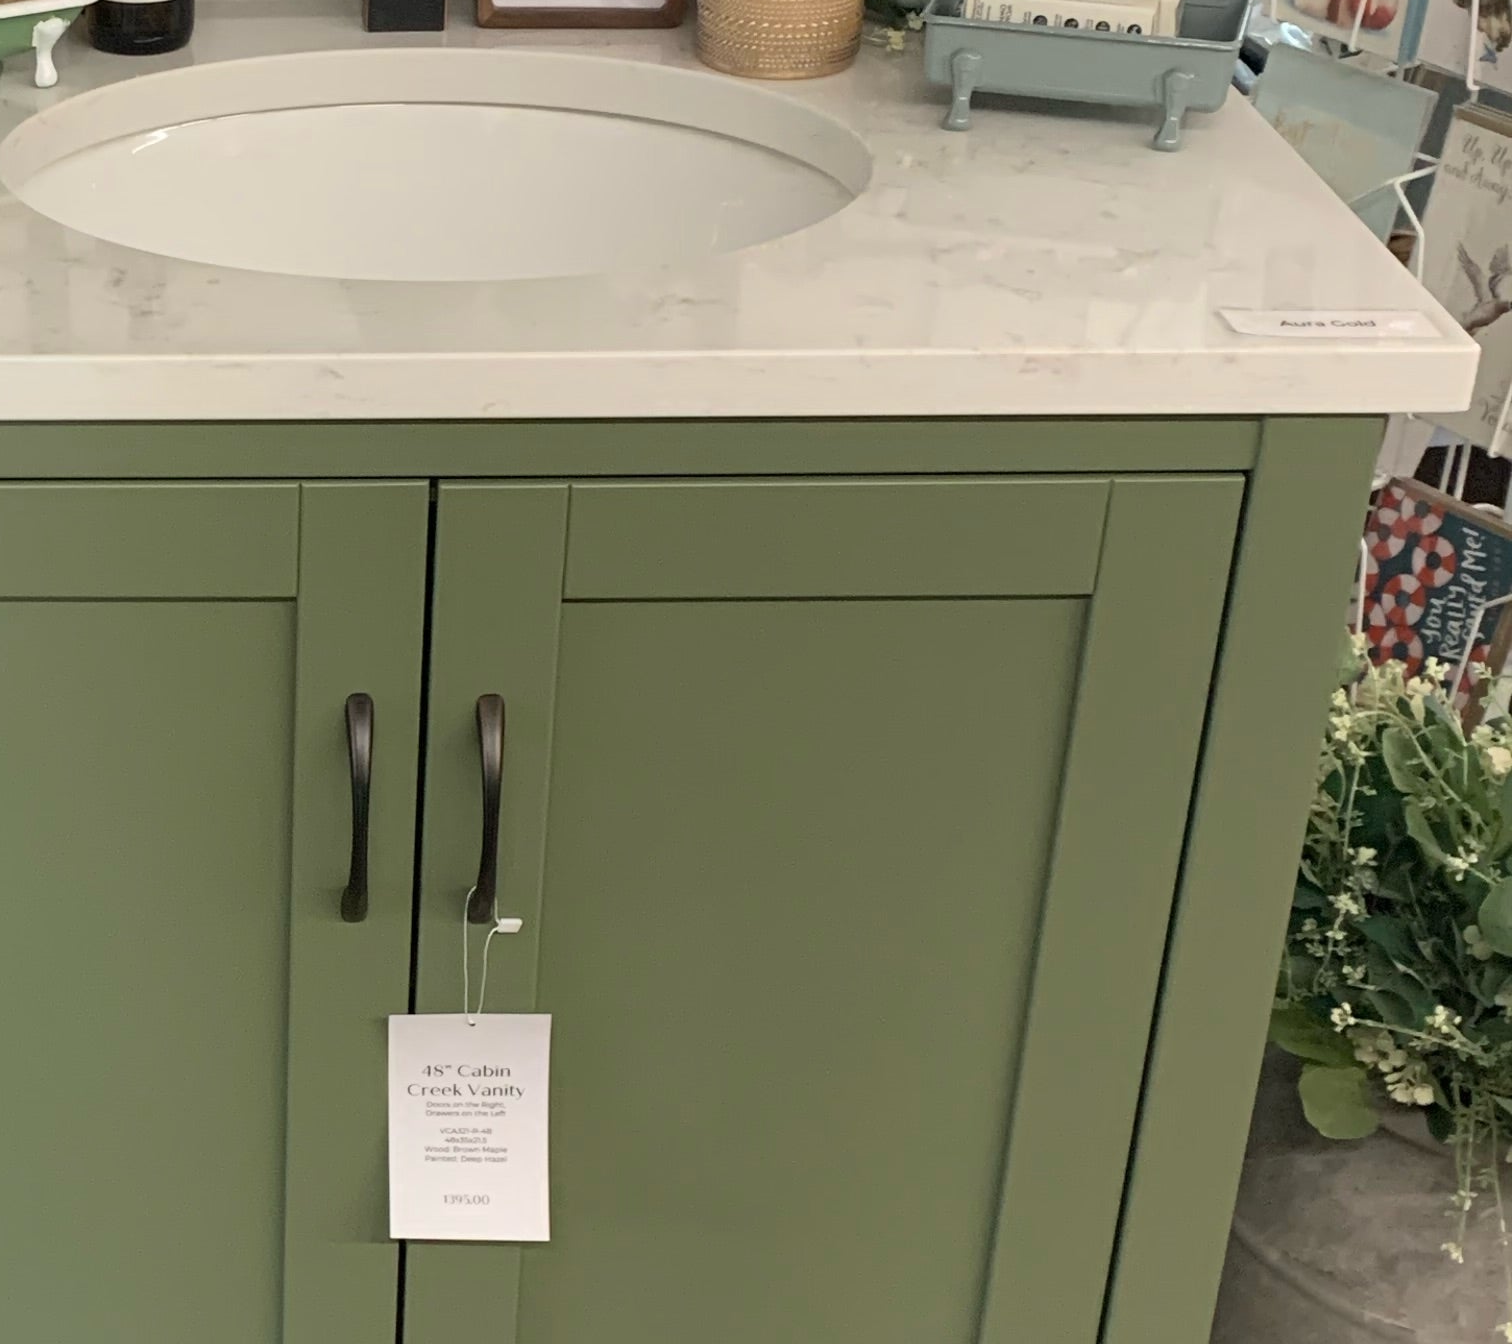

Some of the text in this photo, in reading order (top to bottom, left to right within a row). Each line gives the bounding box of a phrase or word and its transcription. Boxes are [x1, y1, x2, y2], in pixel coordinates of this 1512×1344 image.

[457, 1064, 511, 1077] Cabin
[407, 1083, 527, 1100] Creek Vanity
